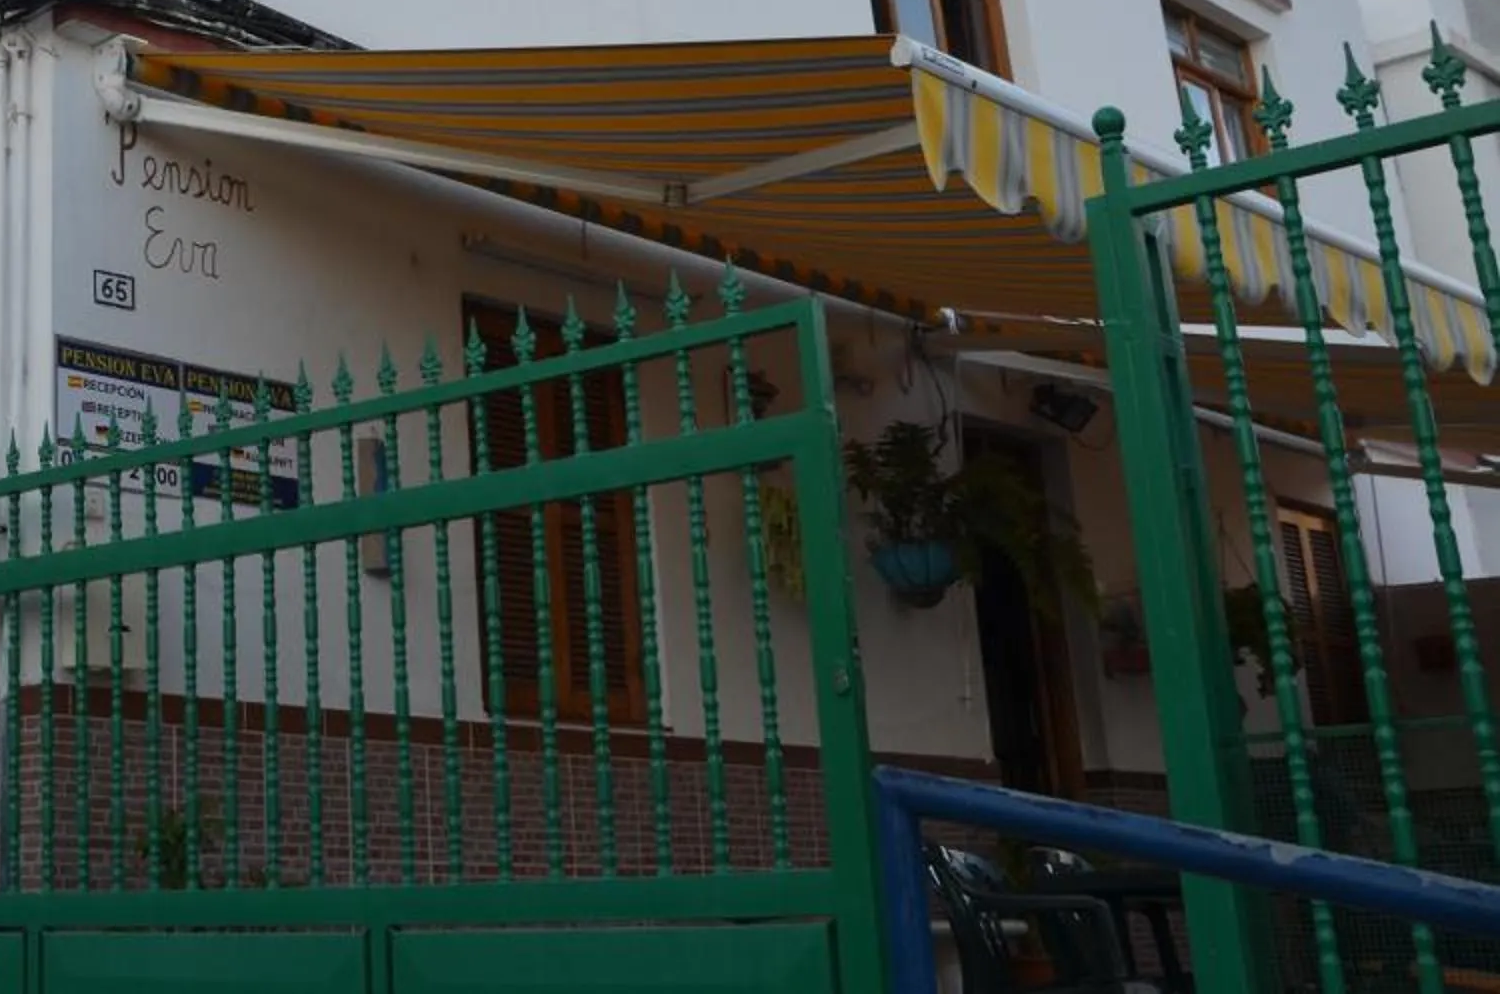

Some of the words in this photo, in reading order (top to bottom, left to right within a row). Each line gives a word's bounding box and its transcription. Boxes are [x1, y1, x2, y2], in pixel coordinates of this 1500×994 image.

[105, 118, 254, 212] Pension
[143, 205, 220, 281] Eva
[100, 277, 129, 303] 65
[62, 348, 137, 378] PENSION
[141, 362, 176, 387] EVA
[187, 369, 256, 400] PENION
